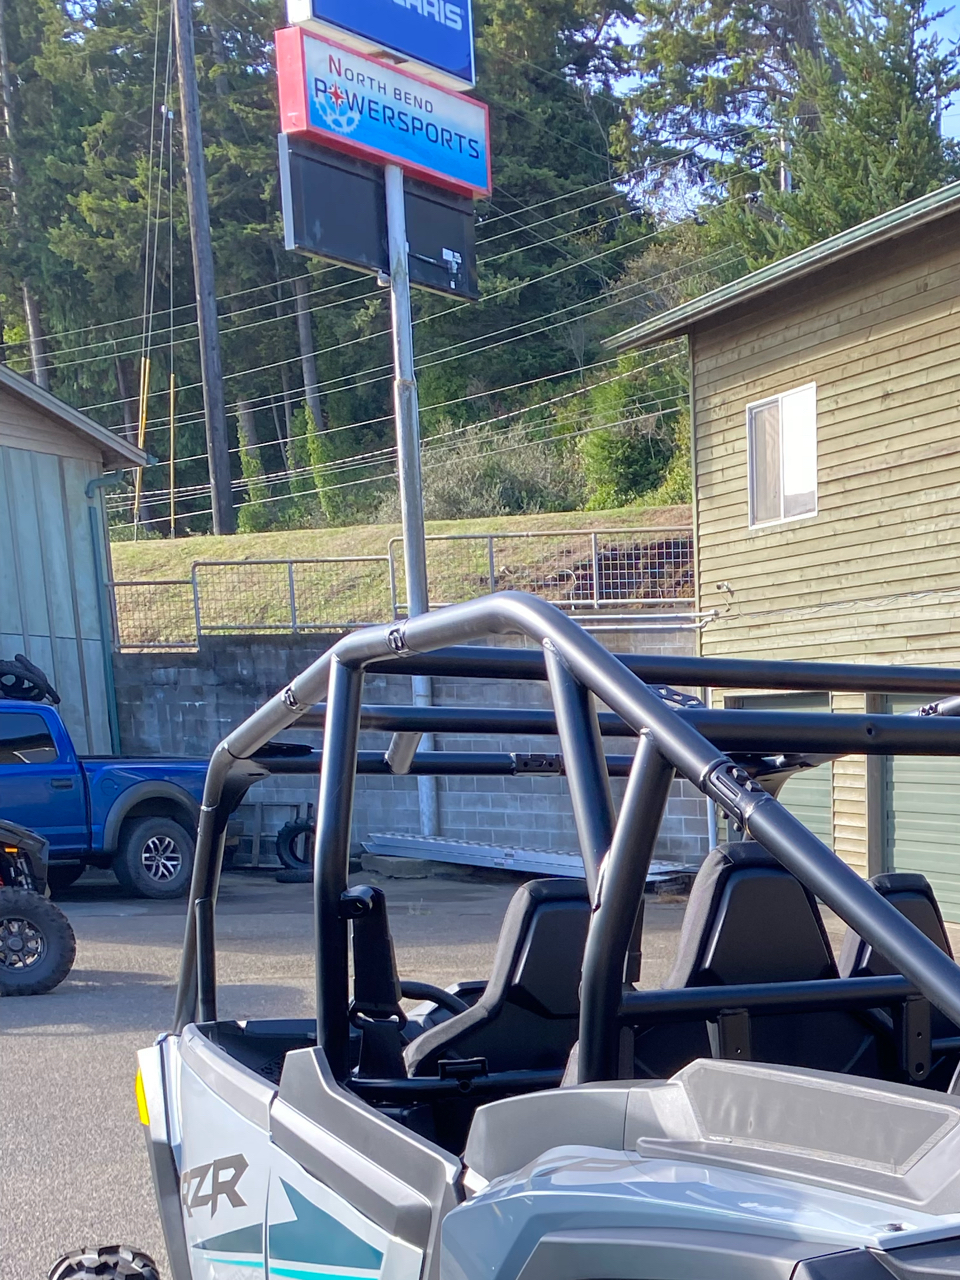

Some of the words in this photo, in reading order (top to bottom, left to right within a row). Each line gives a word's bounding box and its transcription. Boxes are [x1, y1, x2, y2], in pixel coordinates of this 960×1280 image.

[314, 77, 480, 159] POWERSPORTS
[393, 88, 433, 114] BEND
[182, 1153, 249, 1220] RZR
